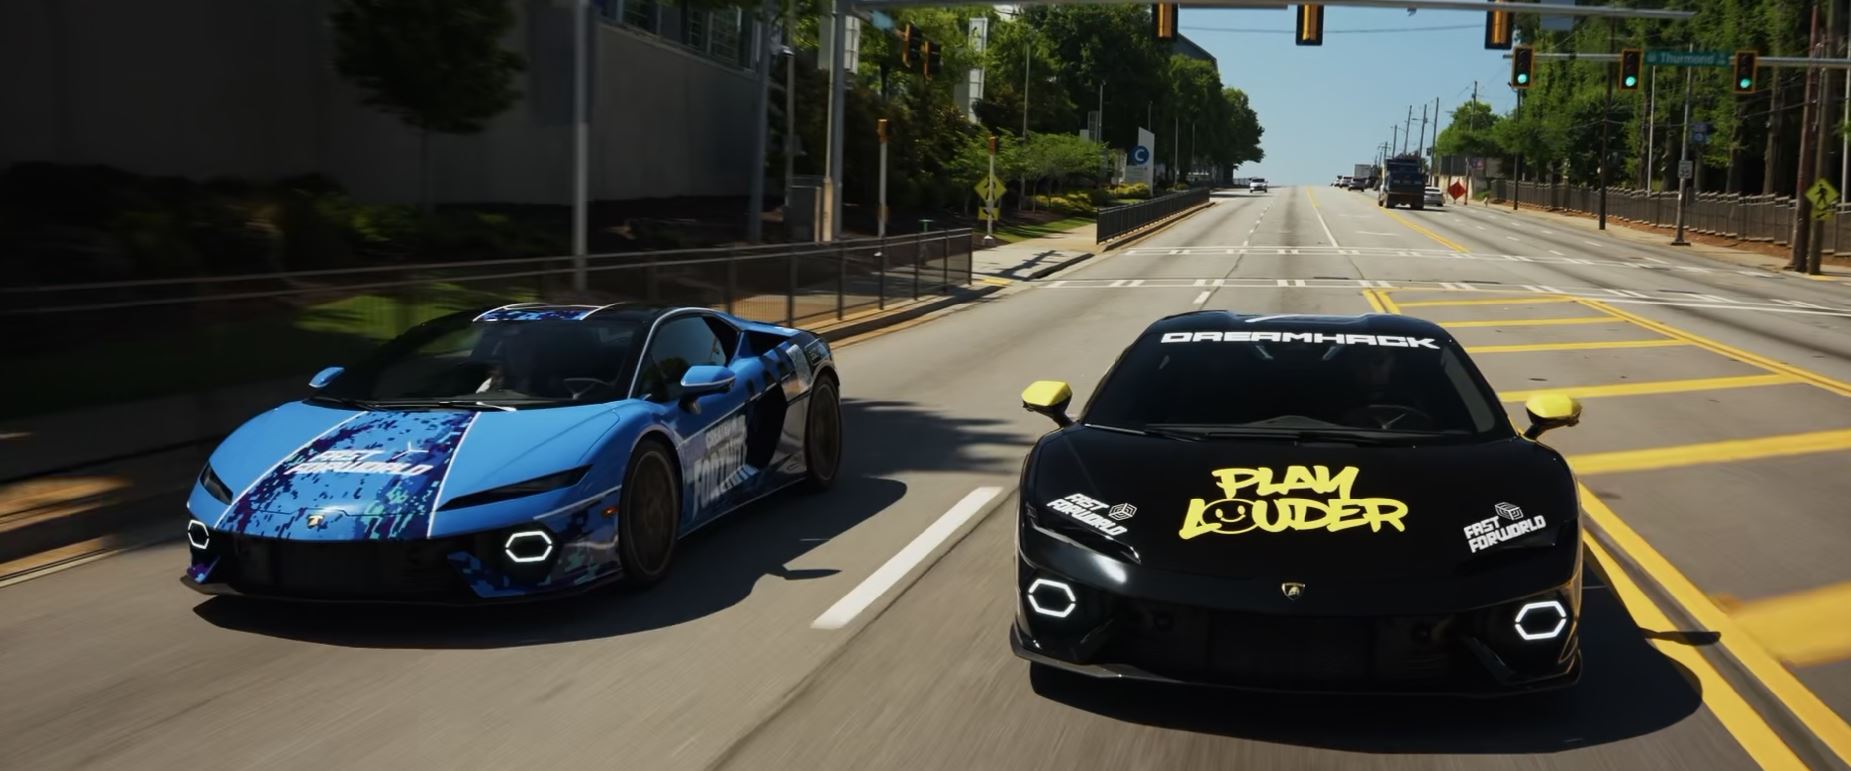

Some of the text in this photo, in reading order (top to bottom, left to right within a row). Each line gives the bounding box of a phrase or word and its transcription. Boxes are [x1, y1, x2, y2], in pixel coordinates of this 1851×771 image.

[1660, 52, 1714, 64] Thurmond
[1160, 331, 1440, 349] DREAMHACK
[1211, 465, 1360, 500] PLAY
[1063, 492, 1110, 511] FAST
[1046, 498, 1128, 536] FORWORLD
[1178, 498, 1408, 540] LOUDER
[1463, 515, 1500, 540] FAST
[1468, 515, 1546, 553] FORWORLD
